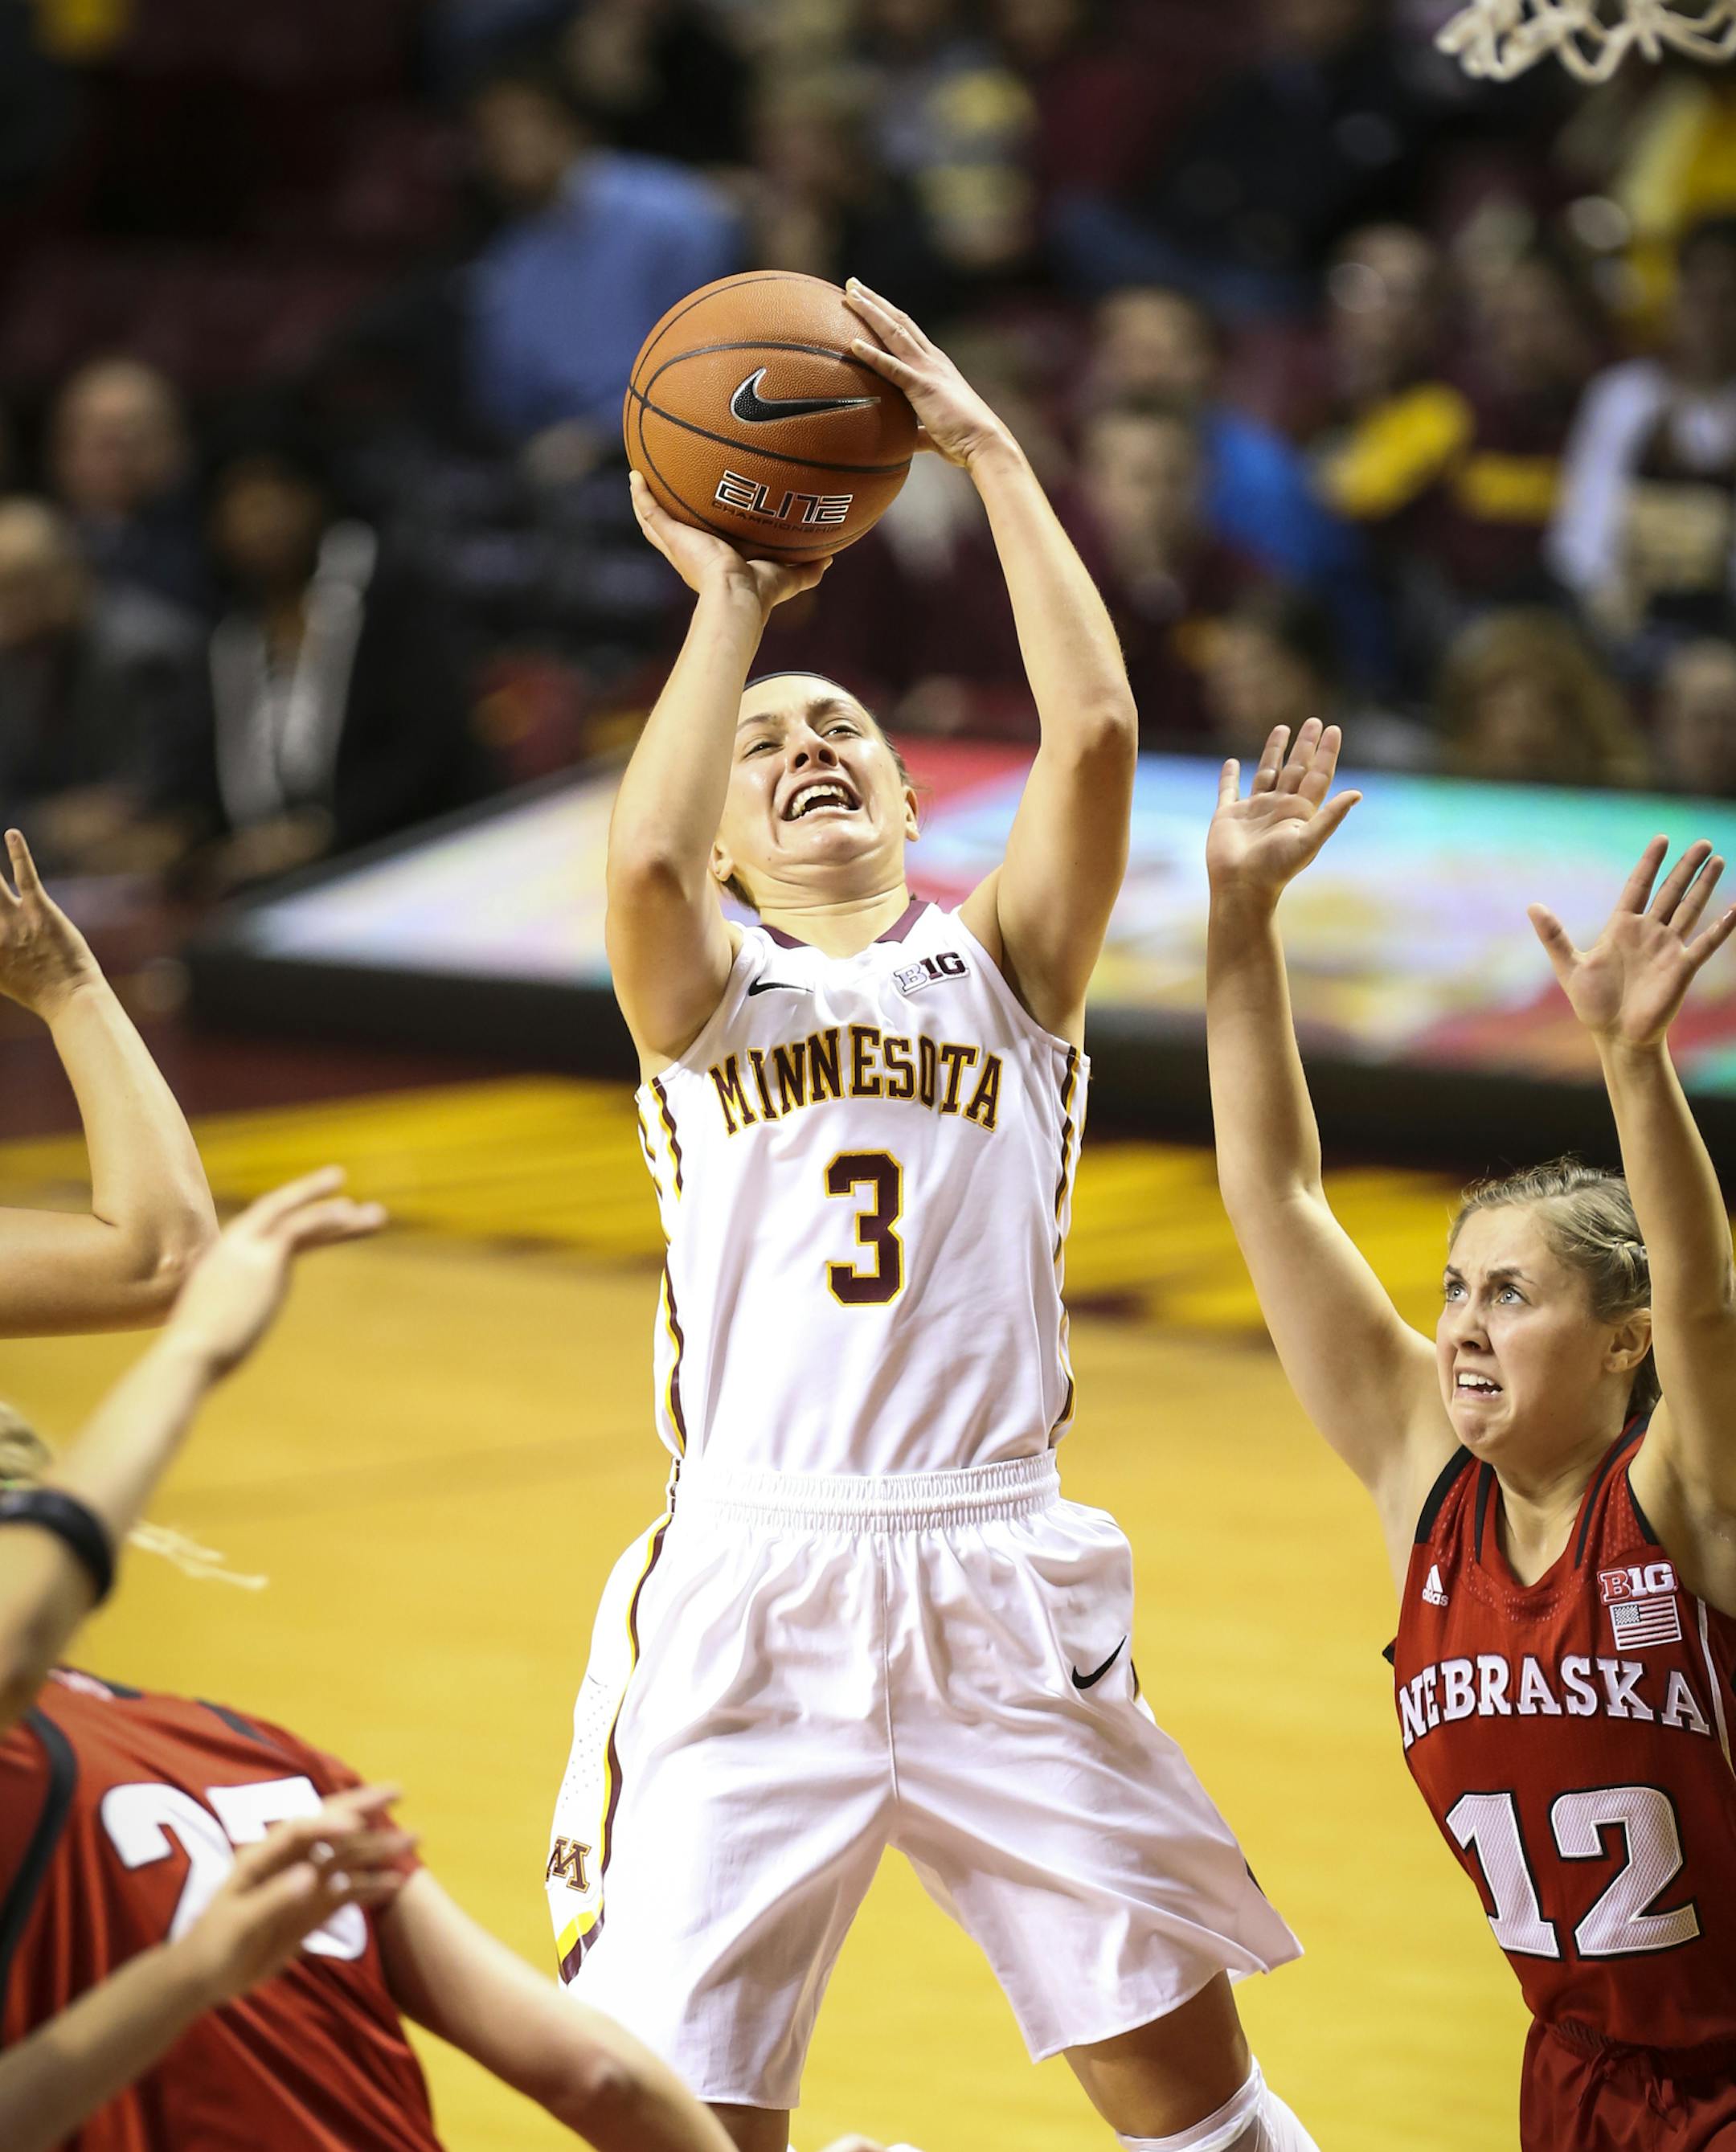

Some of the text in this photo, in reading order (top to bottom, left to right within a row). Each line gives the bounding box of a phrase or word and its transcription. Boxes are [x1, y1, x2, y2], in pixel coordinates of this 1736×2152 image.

[712, 501, 841, 532] CHAMPIONSHIP
[715, 470, 853, 524] ELITE
[708, 1025, 1003, 1136] MINNESOTA
[825, 1150, 905, 1307] 3
[1398, 1653, 1711, 1750] NEBRASKA
[545, 1835, 592, 1893] M
[1446, 1786, 1701, 1958] 12
